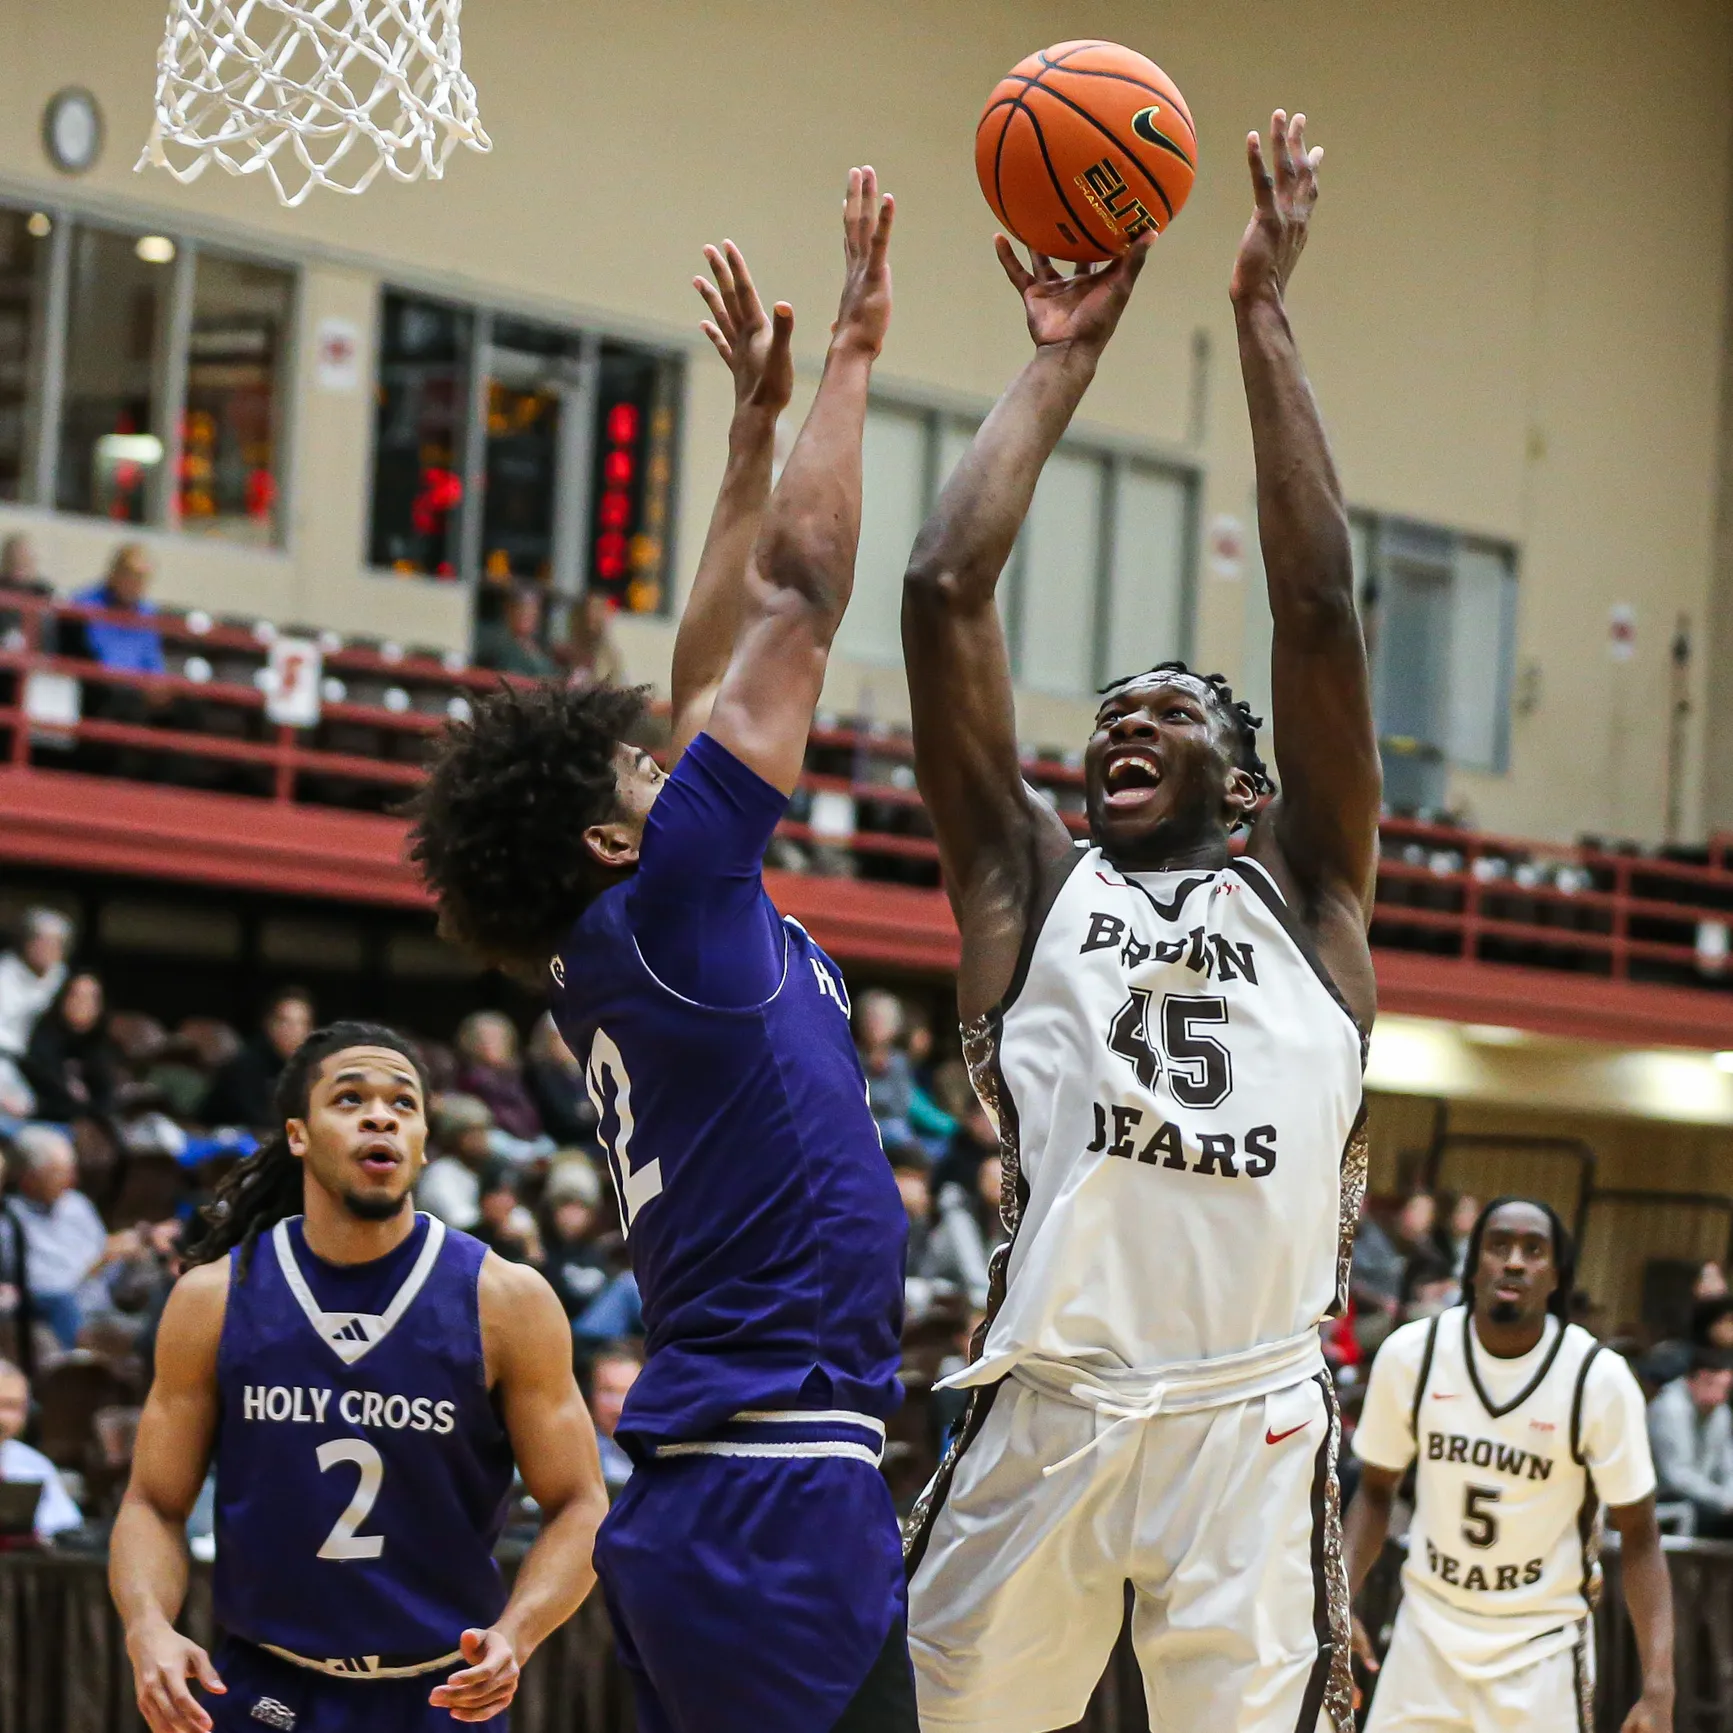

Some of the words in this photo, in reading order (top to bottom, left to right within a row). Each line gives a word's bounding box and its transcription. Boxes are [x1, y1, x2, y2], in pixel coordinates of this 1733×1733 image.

[1107, 986, 1233, 1109] 45
[243, 1385, 332, 1424] HOLY
[339, 1389, 456, 1435] CROSS
[1428, 1431, 1554, 1481] BROWN
[316, 1438, 385, 1560] 2
[1462, 1482, 1502, 1550] 5
